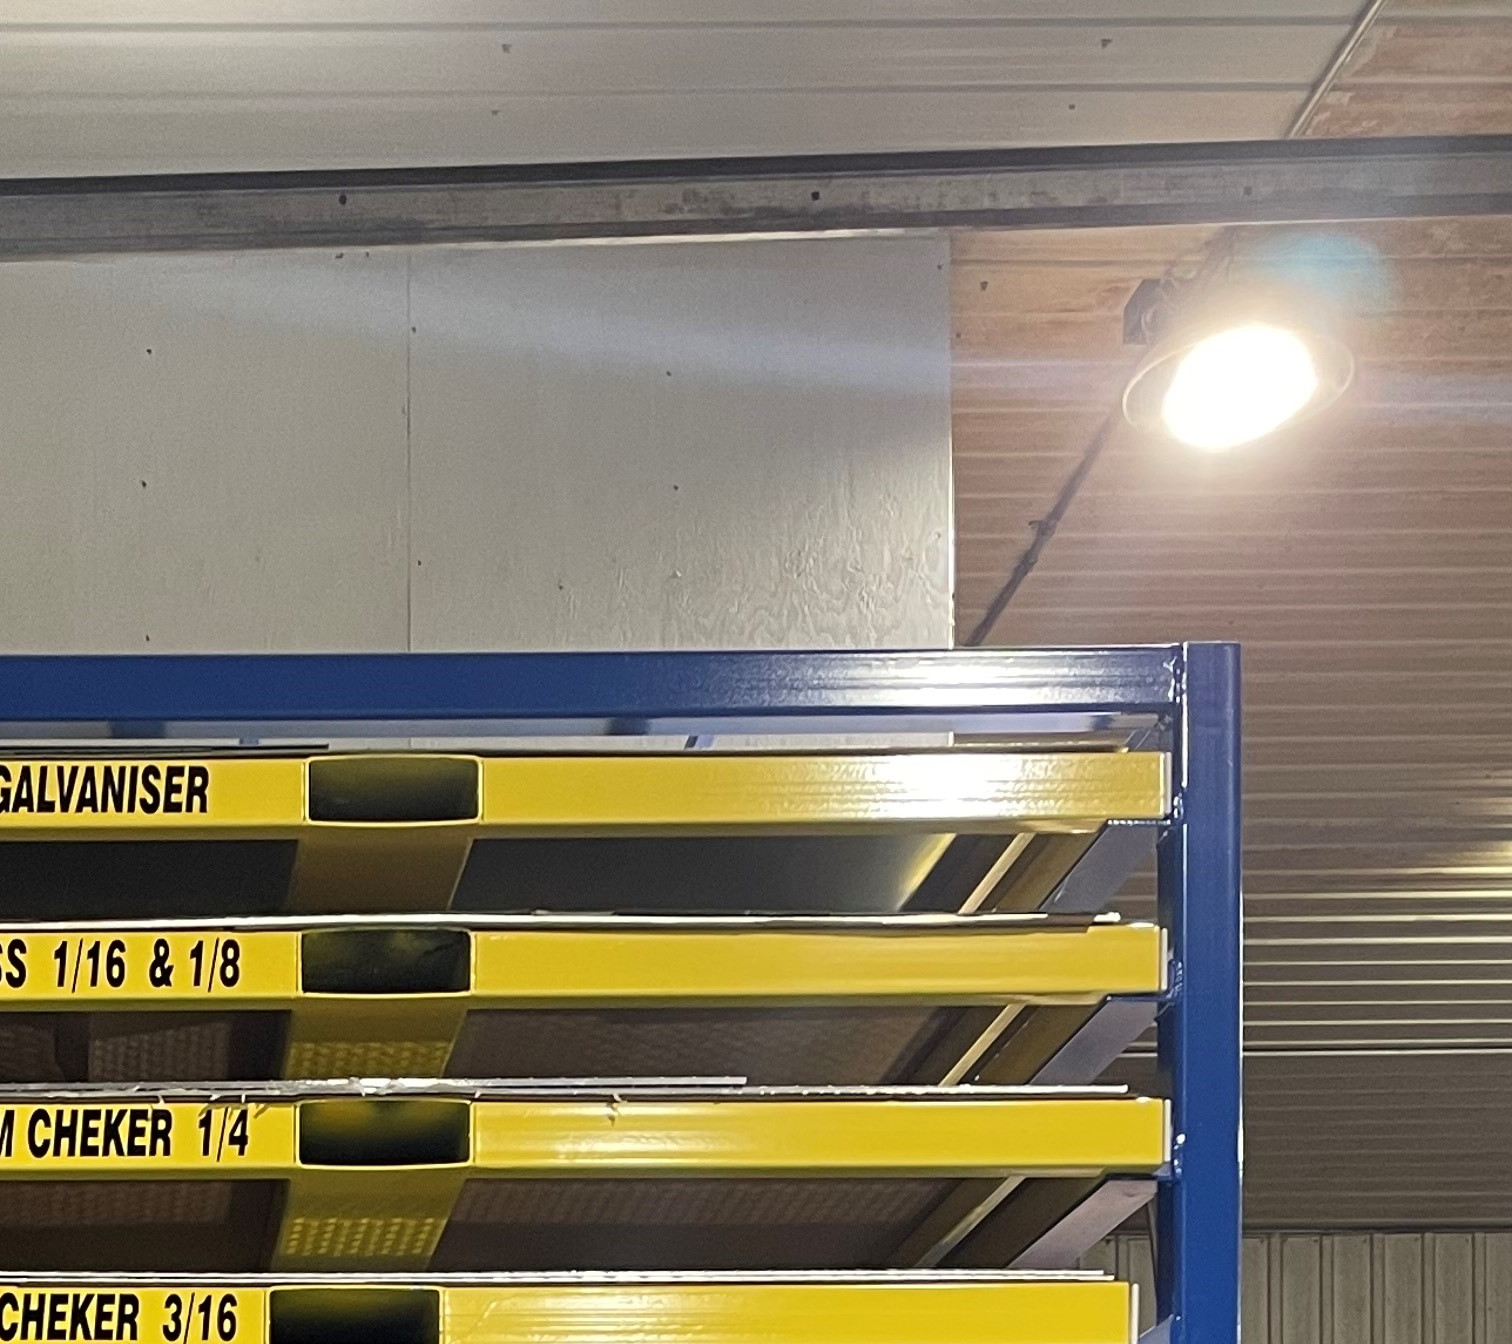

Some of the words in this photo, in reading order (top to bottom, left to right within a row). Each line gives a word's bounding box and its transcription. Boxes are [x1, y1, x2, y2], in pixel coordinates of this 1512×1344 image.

[52, 937, 127, 994] 1/16
[147, 937, 175, 989] &
[188, 937, 241, 993] 1/8
[26, 1108, 173, 1159] CHEKER
[197, 1108, 250, 1162] 1/4
